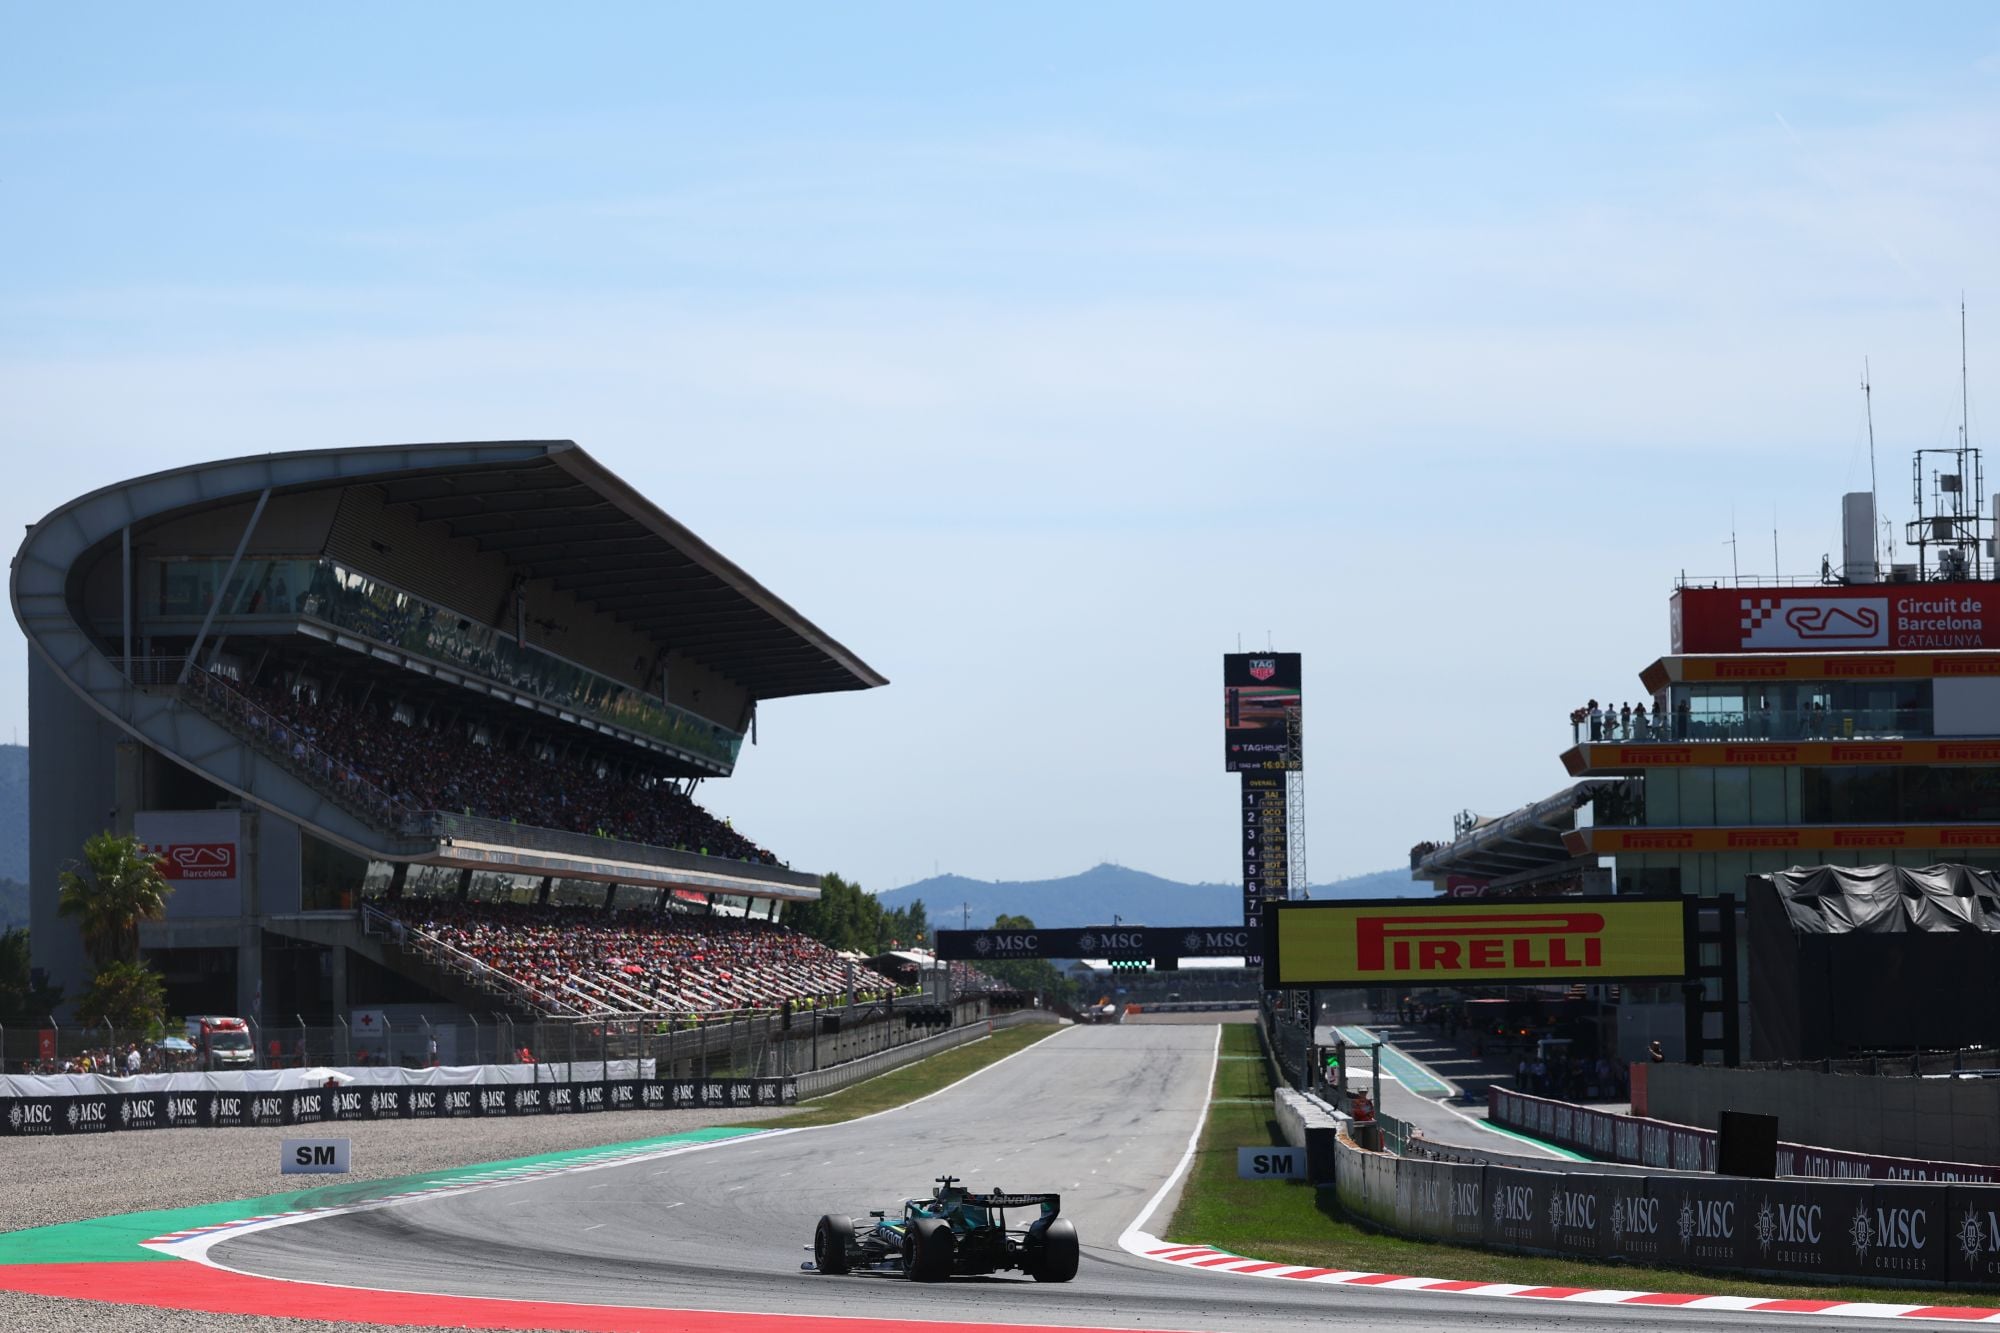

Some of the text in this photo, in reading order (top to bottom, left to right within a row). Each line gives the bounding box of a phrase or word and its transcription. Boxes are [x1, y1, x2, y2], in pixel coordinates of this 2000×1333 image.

[1897, 597, 1982, 613] Circuit de
[1898, 615, 1982, 630] Barcelona
[1898, 634, 1983, 647] CATALUNYA
[1716, 661, 1787, 677] PIRELLI
[1824, 659, 1896, 675] PIRELLI
[1933, 657, 2000, 674] PIRELL
[1620, 748, 1691, 763] PIRELLI
[1725, 747, 1797, 762] PIRELLI
[1832, 745, 1902, 760] PIRELLI
[1248, 794, 1254, 804] 1
[1247, 812, 1255, 822] 2
[1262, 808, 1281, 816] OCO
[1247, 829, 1255, 839] 3
[1622, 833, 1693, 848] PIRELLI
[1728, 832, 1799, 847] PIRELLI
[1834, 830, 1904, 845] PIRELLI
[1247, 847, 1255, 857] 4
[183, 869, 227, 878] Barcelona
[1248, 865, 1256, 875] 5
[1248, 882, 1256, 892] 6
[1249, 900, 1256, 910] 7
[1249, 917, 1257, 927] 8
[995, 936, 1038, 950] MSC
[1101, 933, 1142, 948] MSC
[1206, 932, 1248, 947] MSC
[1356, 913, 1605, 971] PIRELLI
[453, 1091, 471, 1107] MSC
[488, 1091, 505, 1107] MSC
[523, 1089, 540, 1106] MSC
[556, 1088, 572, 1104] MSC
[586, 1087, 603, 1103] MSC
[619, 1085, 633, 1100] MSC
[650, 1085, 664, 1100] MSC
[680, 1084, 694, 1100] MSC
[708, 1084, 723, 1098] MSC
[737, 1084, 751, 1098] MSC
[177, 1098, 197, 1116] MSC
[220, 1098, 241, 1116] MSC
[261, 1098, 282, 1116] MSC
[301, 1095, 321, 1113] MSC
[341, 1093, 361, 1110] MSC
[380, 1092, 398, 1109] MSC
[417, 1092, 436, 1108] MSC
[24, 1104, 52, 1123] MSC
[80, 1102, 107, 1121] MSC
[132, 1100, 155, 1118] MSC
[296, 1146, 335, 1166] SM
[1253, 1155, 1293, 1175] SM
[986, 1194, 1047, 1205] Valvoline
[1457, 1183, 1479, 1216] MSC
[1506, 1185, 1533, 1221] MSC
[1565, 1192, 1596, 1230] MSC
[1626, 1197, 1659, 1234] MSC
[1697, 1200, 1734, 1238] MSC
[1778, 1203, 1821, 1244] MSC
[1876, 1207, 1926, 1249] MSC
[1696, 1246, 1734, 1258] CRUISES
[1777, 1250, 1822, 1264] CRUISES
[1875, 1255, 1927, 1270] CRUISES
